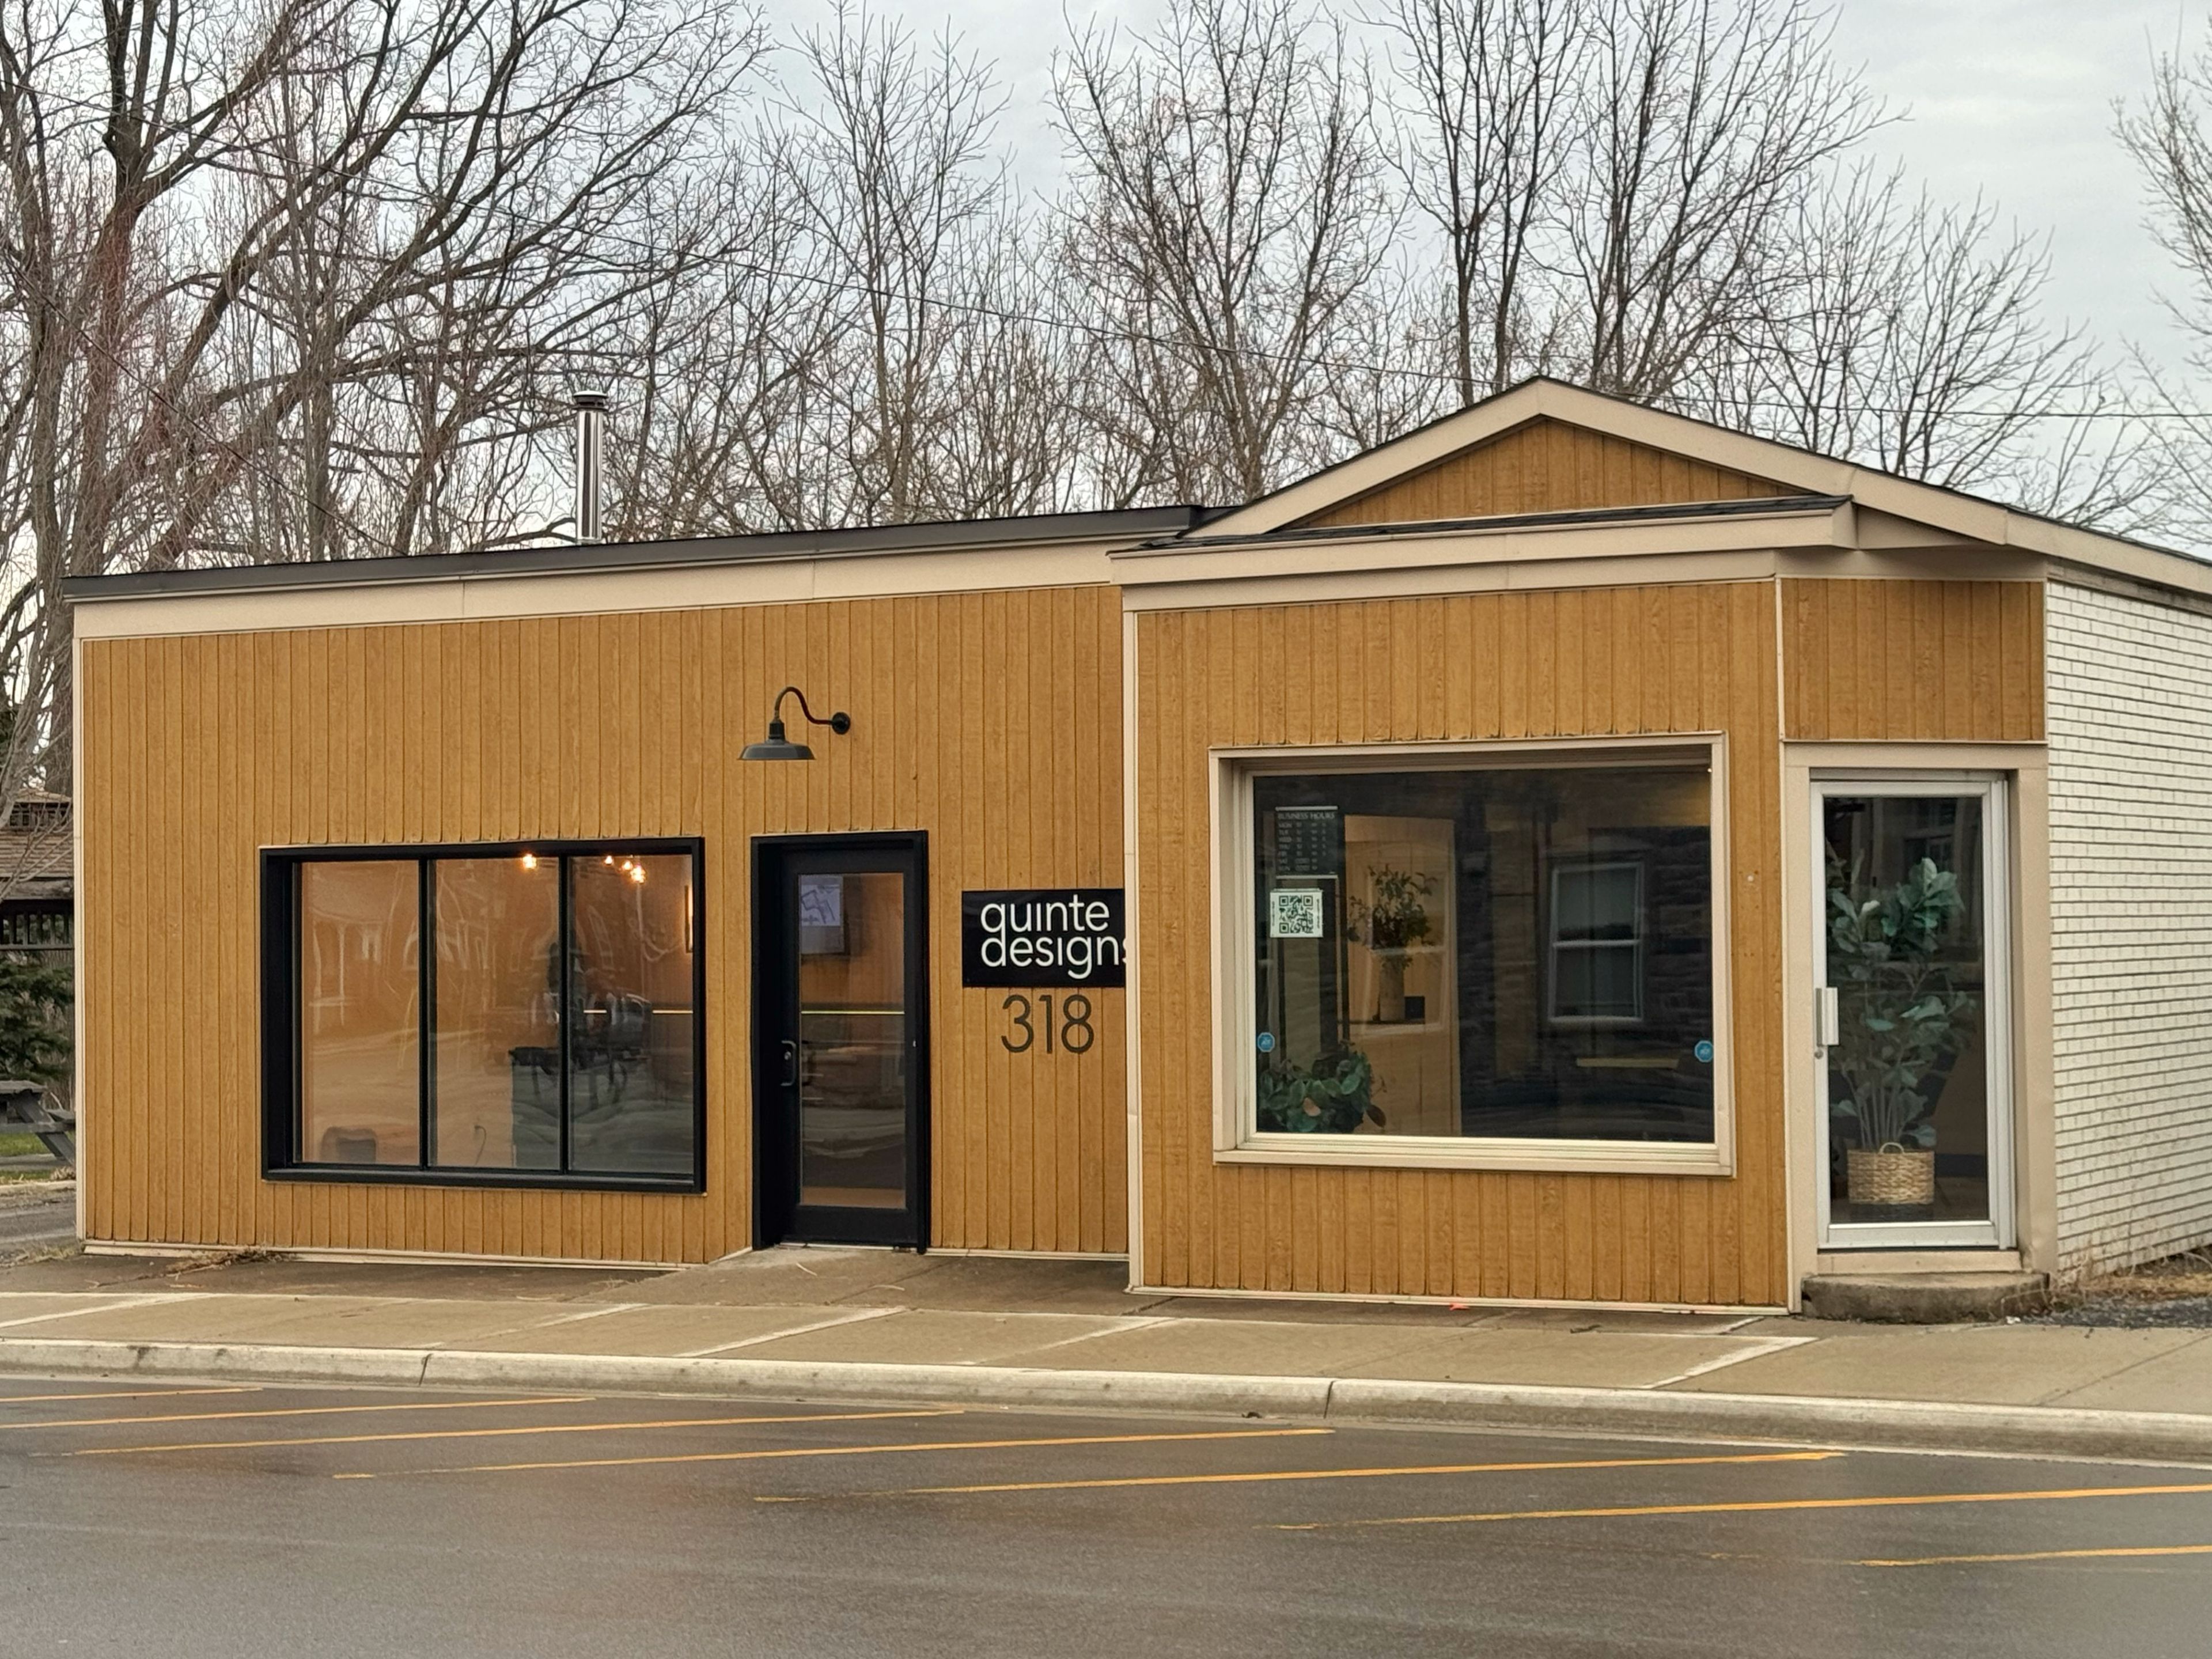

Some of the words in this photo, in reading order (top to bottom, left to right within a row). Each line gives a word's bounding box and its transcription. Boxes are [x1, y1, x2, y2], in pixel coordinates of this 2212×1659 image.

[1278, 812, 1309, 820] BUSINESS
[1310, 811, 1335, 820] HOURS
[980, 894, 1109, 940] quinte
[981, 931, 1126, 979] design
[1001, 994, 1094, 1054] 318
